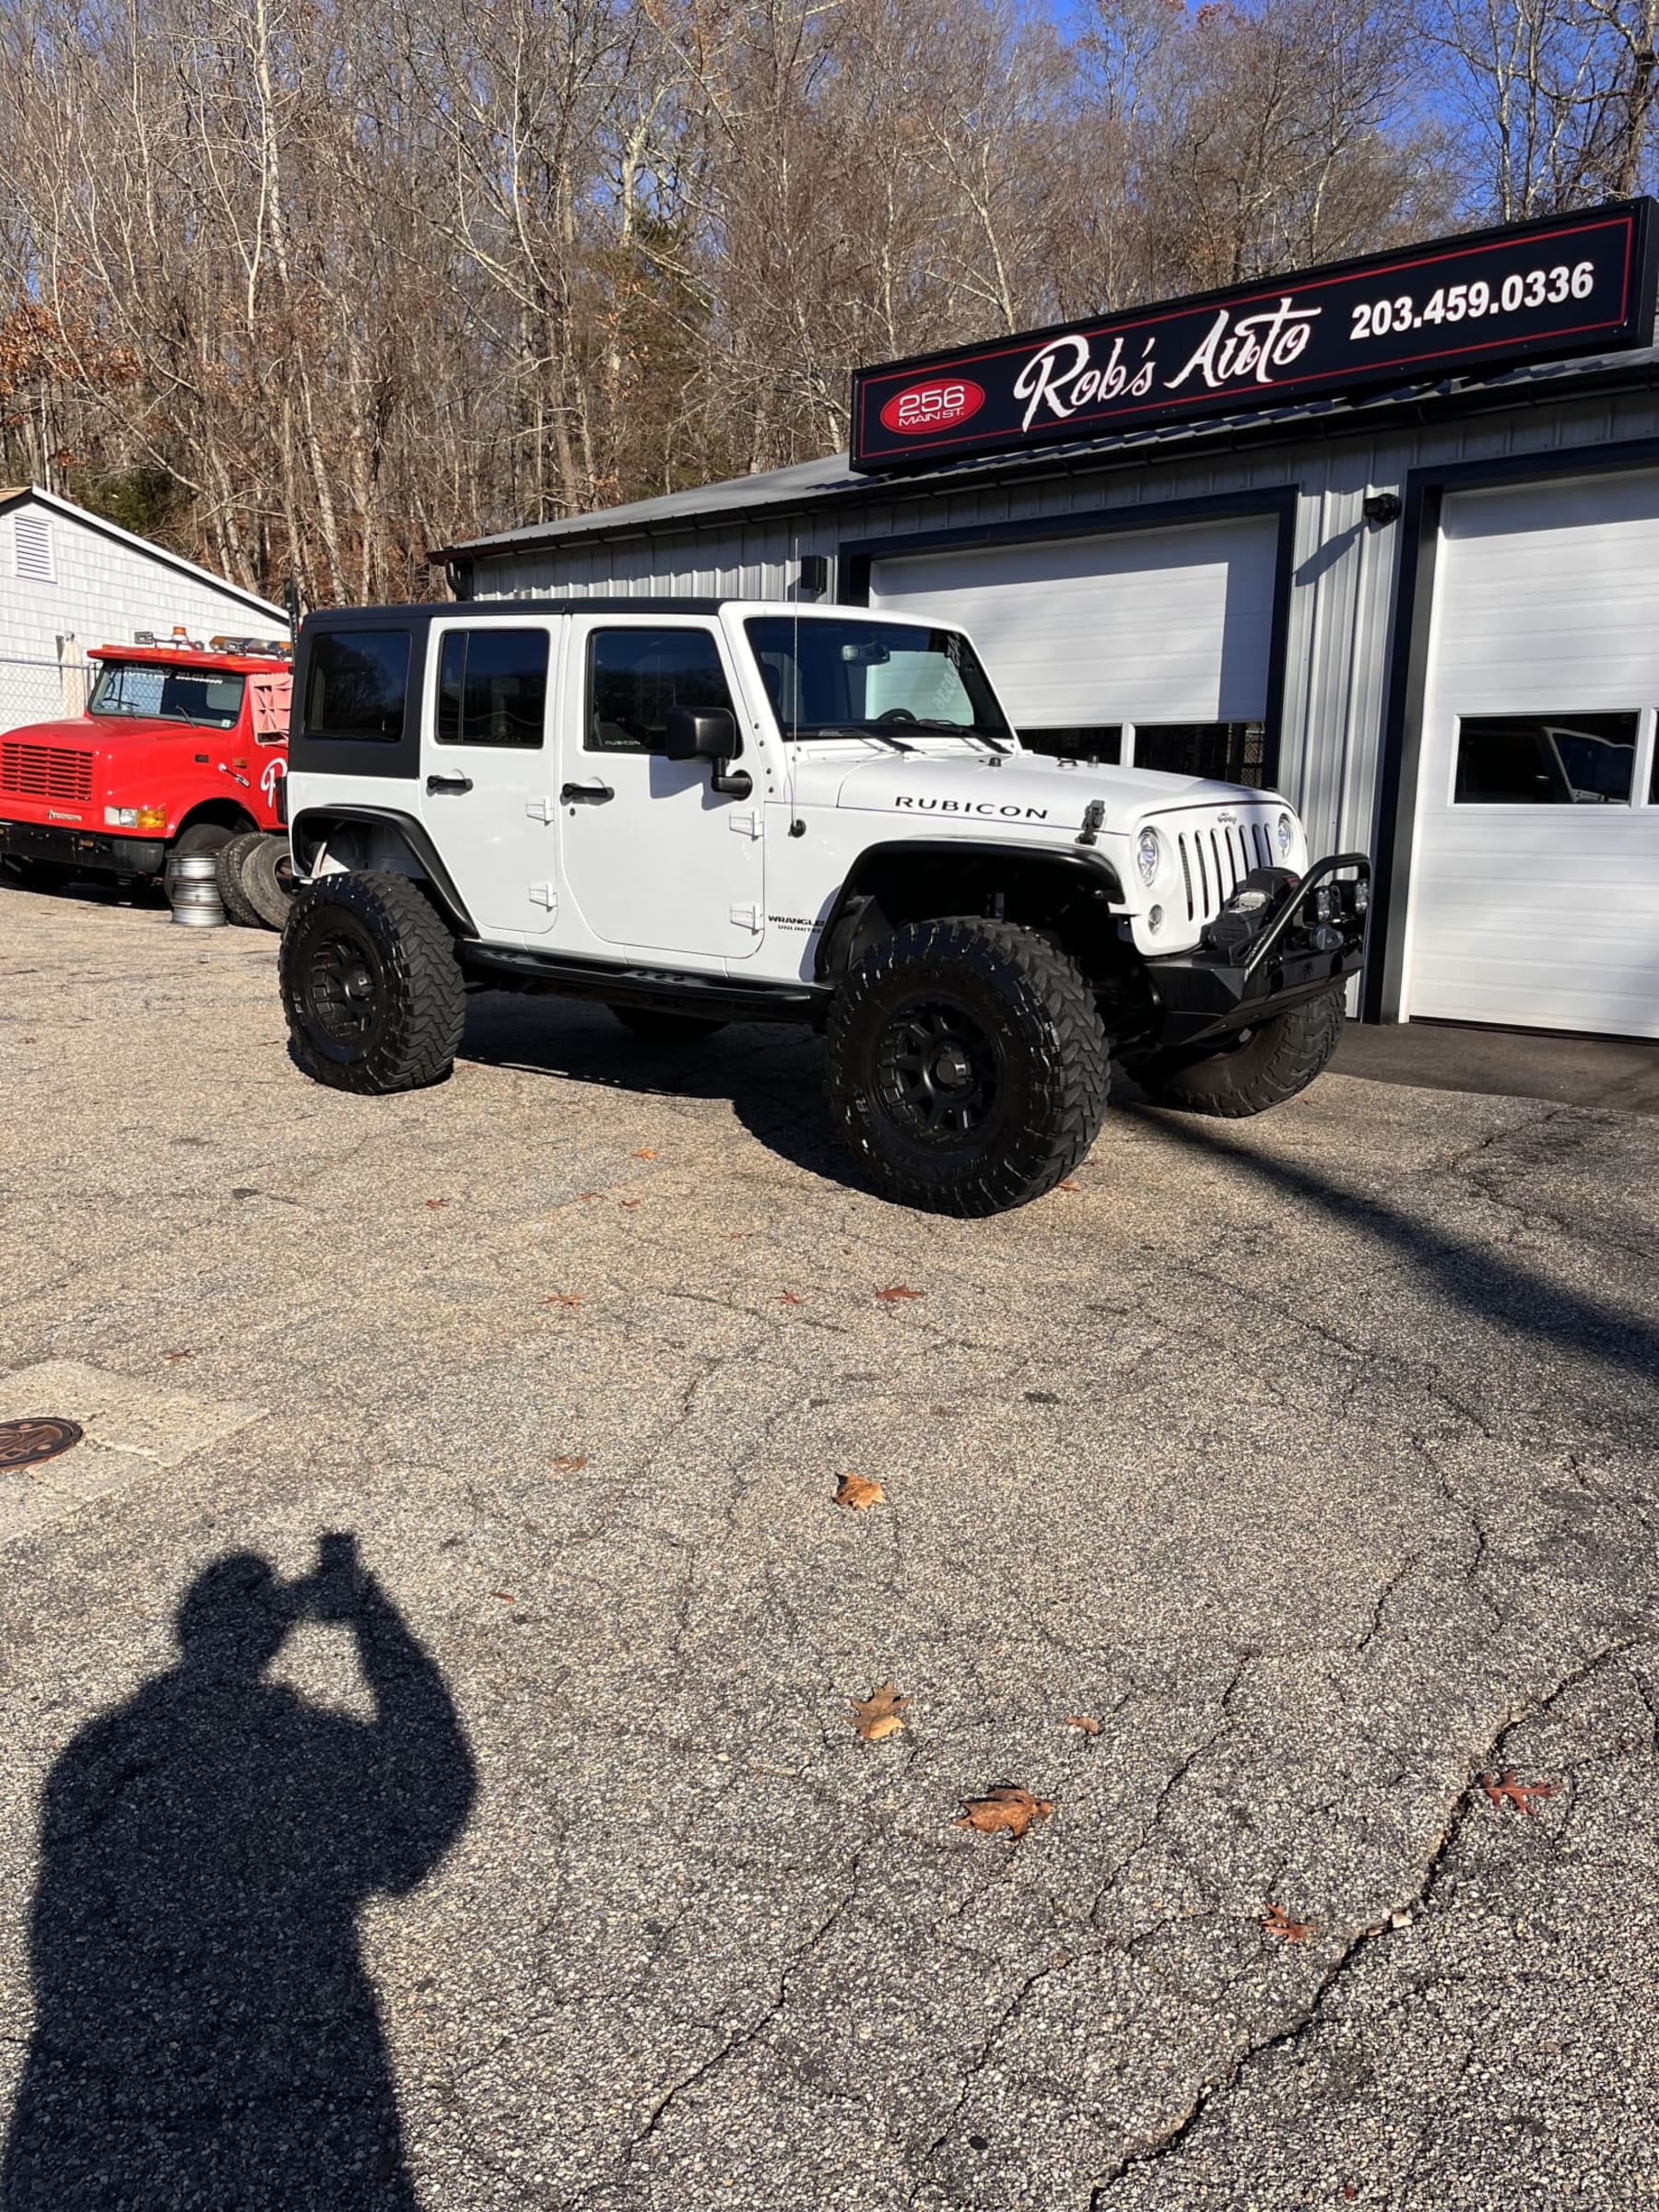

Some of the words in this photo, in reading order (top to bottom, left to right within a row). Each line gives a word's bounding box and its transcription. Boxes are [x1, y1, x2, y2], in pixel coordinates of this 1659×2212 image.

[1349, 261, 1595, 340] 203.459.0336
[1013, 334, 1156, 432] Rob's
[1162, 297, 1323, 388] Auto
[899, 385, 965, 418] 256
[899, 412, 941, 427] MAIN
[942, 406, 965, 419] ST.
[894, 795, 1049, 819] RUBICON
